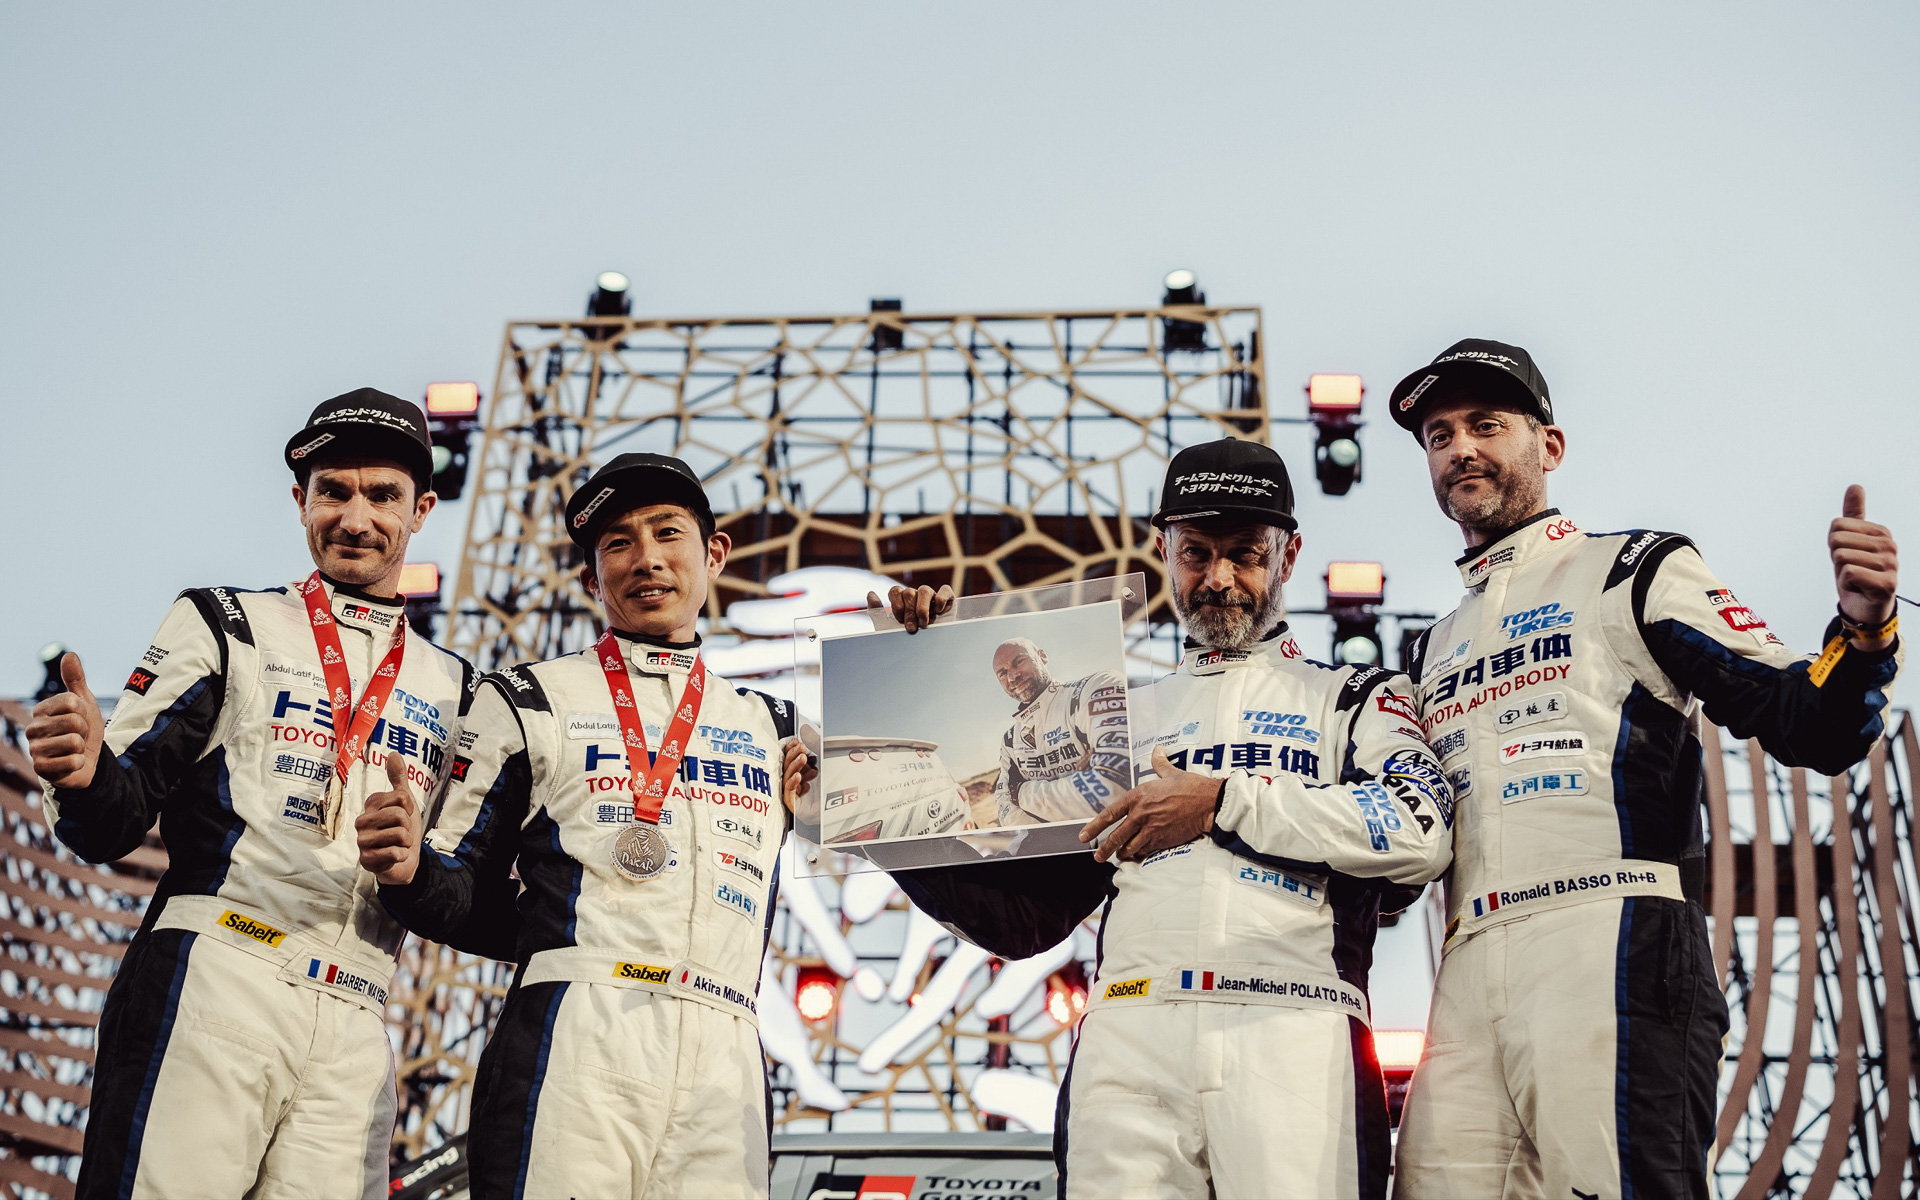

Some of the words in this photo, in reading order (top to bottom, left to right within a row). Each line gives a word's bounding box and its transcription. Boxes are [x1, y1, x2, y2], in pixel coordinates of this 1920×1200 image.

[1174, 472, 1279, 489] チームランドクルーザー
[1488, 546, 1515, 559] TOYOTA
[1488, 552, 1513, 563] GAZOO
[1620, 530, 1660, 566] Sabelt
[210, 588, 245, 621] Sabelt
[371, 609, 394, 619] TOYOTA
[1501, 602, 1561, 629] TOYO
[312, 618, 332, 626] DAKAR
[1508, 611, 1575, 640] TIRES
[265, 663, 291, 674] Abdul
[292, 667, 312, 679] Latif
[324, 656, 344, 666] DAKAR
[377, 669, 397, 678] DAKAR
[497, 667, 534, 693] Sabelt
[1347, 667, 1385, 692] Sabelt
[1420, 633, 1573, 719] トヨタ車体
[333, 699, 350, 710] DAKAR
[360, 702, 379, 718] DAKAR
[394, 688, 440, 720] TOYO
[615, 700, 635, 709] DAKAR
[1093, 700, 1127, 712] MOT
[1422, 702, 1464, 734] OYOTA
[1467, 681, 1511, 713] AUTO
[1515, 664, 1571, 691] BODY
[403, 706, 448, 742] TIRES
[570, 721, 596, 731] Abdul
[677, 712, 695, 725] DAKAR
[1242, 710, 1308, 726] TOYO
[626, 740, 645, 749] DAKAR
[698, 725, 753, 744] TOYO
[1250, 722, 1321, 745] TIRES
[1433, 729, 1466, 759] 田通商
[661, 749, 680, 762] DAKAR
[710, 739, 767, 762] TIRES
[1521, 738, 1584, 753] トヨタ紡織
[271, 725, 340, 753] TOYOT
[357, 749, 388, 771] AUT
[407, 763, 437, 798] BODY
[274, 753, 340, 785] 豊田通
[585, 744, 772, 798] ト車体
[645, 788, 663, 798] DAKAR
[1388, 760, 1454, 815] ENDLESS
[1503, 773, 1583, 799] 古河電工
[286, 795, 321, 816] 関西ペ
[672, 786, 726, 805] AUTO
[730, 792, 770, 816] BODY
[825, 789, 859, 811] GR
[1363, 781, 1402, 831] TOYO
[1382, 773, 1435, 835] PIAA
[283, 809, 319, 826] EGUCHI
[597, 803, 672, 826] 豊田商
[1352, 787, 1390, 851] TIRES
[621, 851, 655, 872] DAKAR
[1240, 867, 1319, 901] 古河電工
[1500, 883, 1551, 906] Ronald
[1554, 874, 1612, 895] BASSO
[1616, 871, 1657, 884] Rh+B
[225, 912, 283, 945] Sabelt
[335, 970, 369, 994] BARBET
[620, 963, 671, 984] Sabelt
[693, 975, 721, 996] Akira
[723, 985, 750, 1010] MIURA
[1107, 980, 1147, 998] Sabelt
[1217, 975, 1288, 995] Jean-Michel
[1290, 982, 1338, 1003] POLATO
[389, 1146, 460, 1197] Racing
[925, 1176, 1042, 1191] TOYOTA
